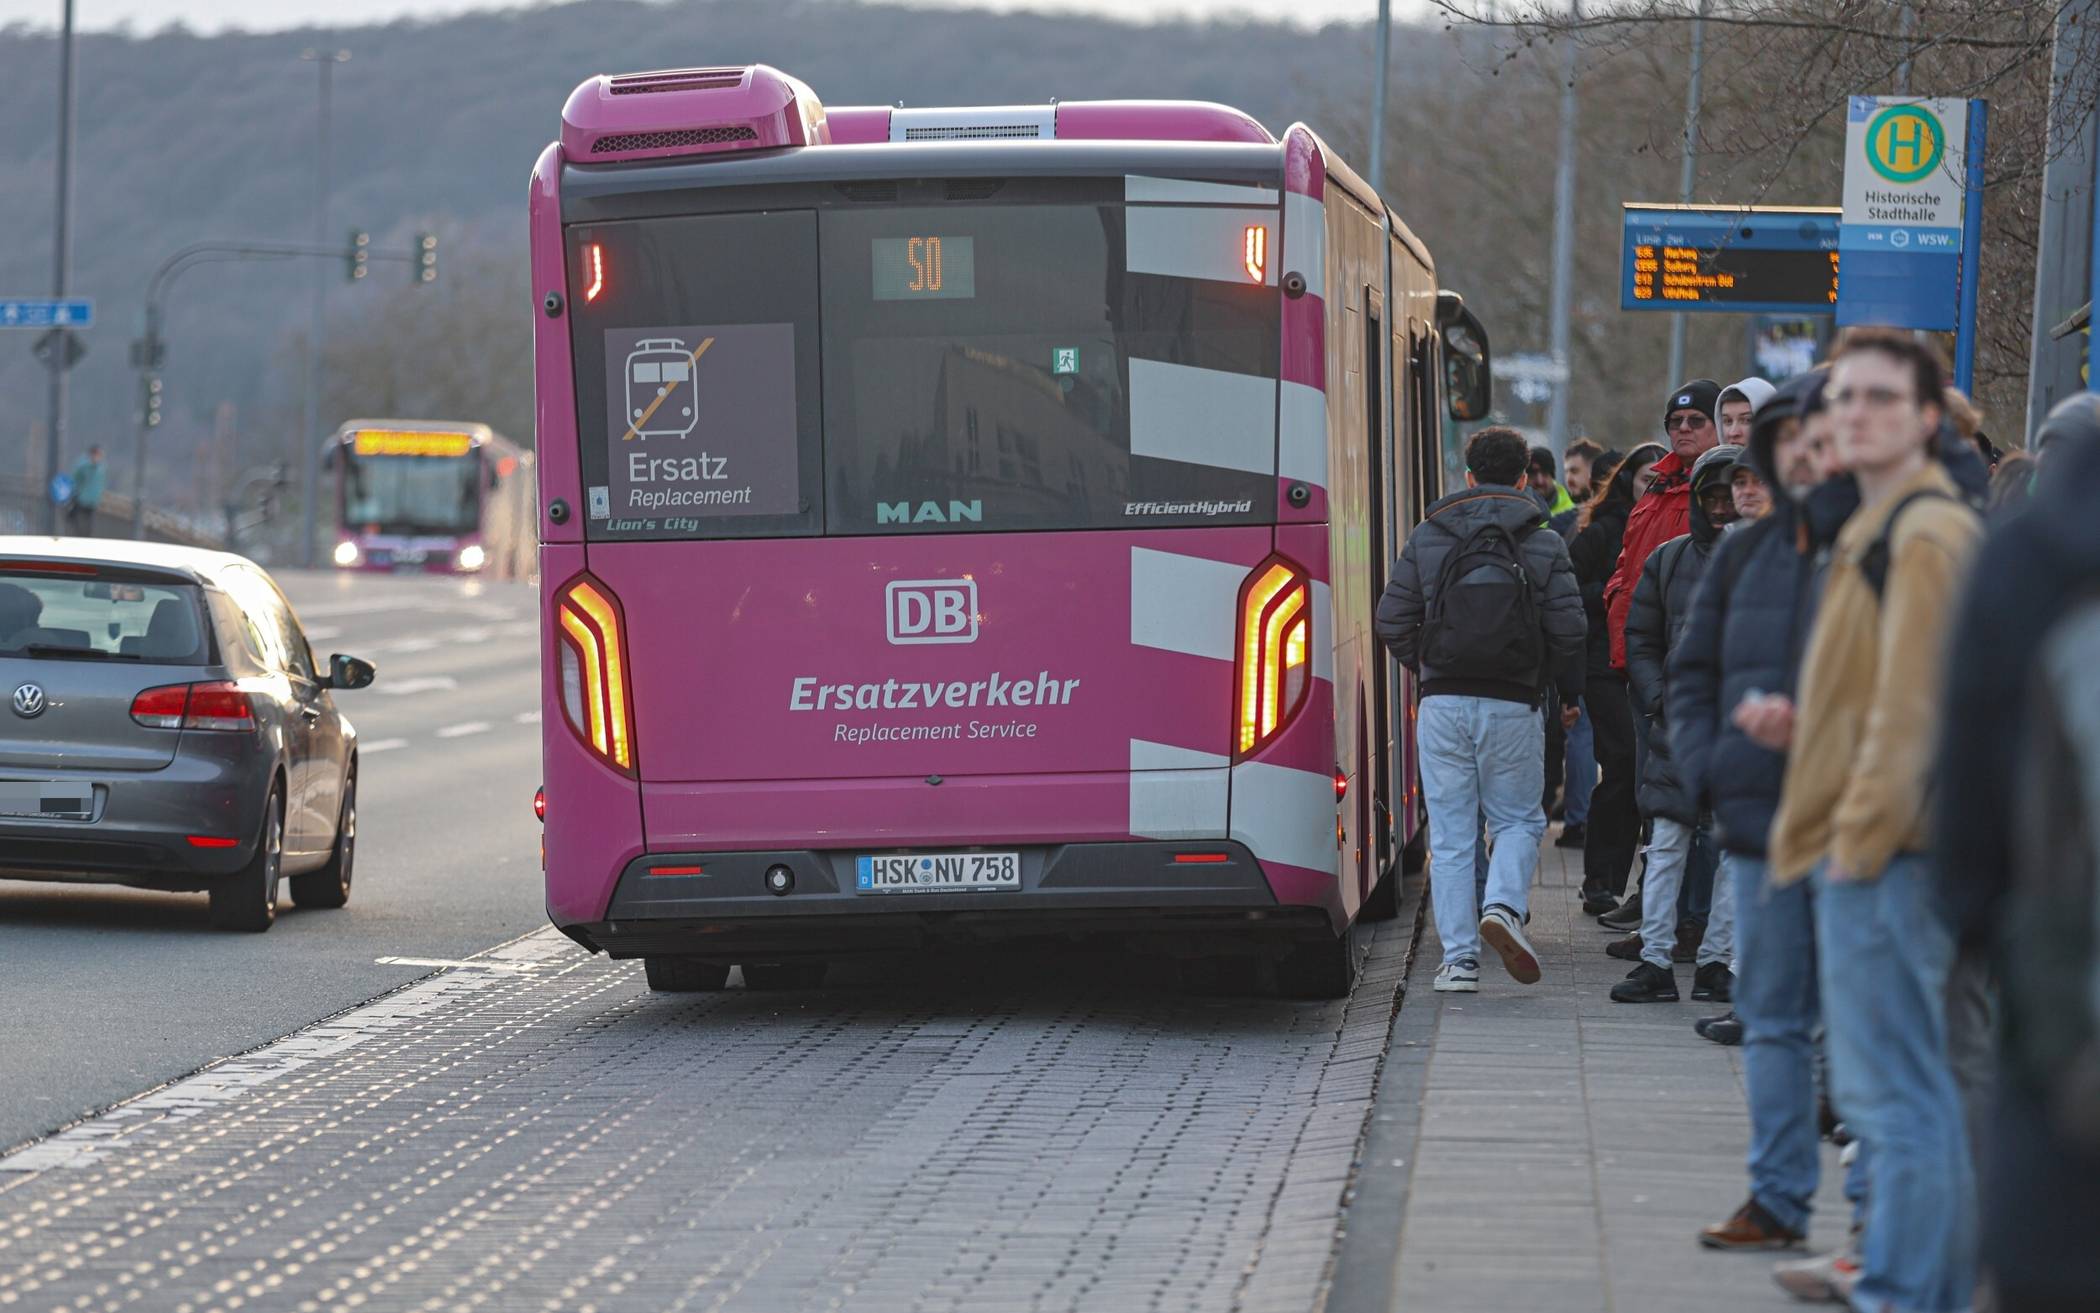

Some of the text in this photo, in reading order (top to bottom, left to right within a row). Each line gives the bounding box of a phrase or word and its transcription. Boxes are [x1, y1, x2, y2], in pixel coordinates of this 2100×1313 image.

[1888, 122, 1923, 166] H
[1865, 190, 1941, 206] Historische
[1868, 206, 1936, 221] Stadthalle
[629, 451, 728, 482] Ersatz
[629, 486, 752, 510] Replacement
[1125, 500, 1252, 516] EfficientHybrid
[606, 517, 699, 531] Lion's City
[877, 500, 982, 524] MAN
[898, 590, 967, 634] DB
[789, 671, 1080, 711] Ersatzverkehr
[834, 720, 1037, 745] Replacement Service
[873, 859, 918, 884] HSK
[935, 858, 965, 883] NV
[971, 856, 1015, 882] 758
